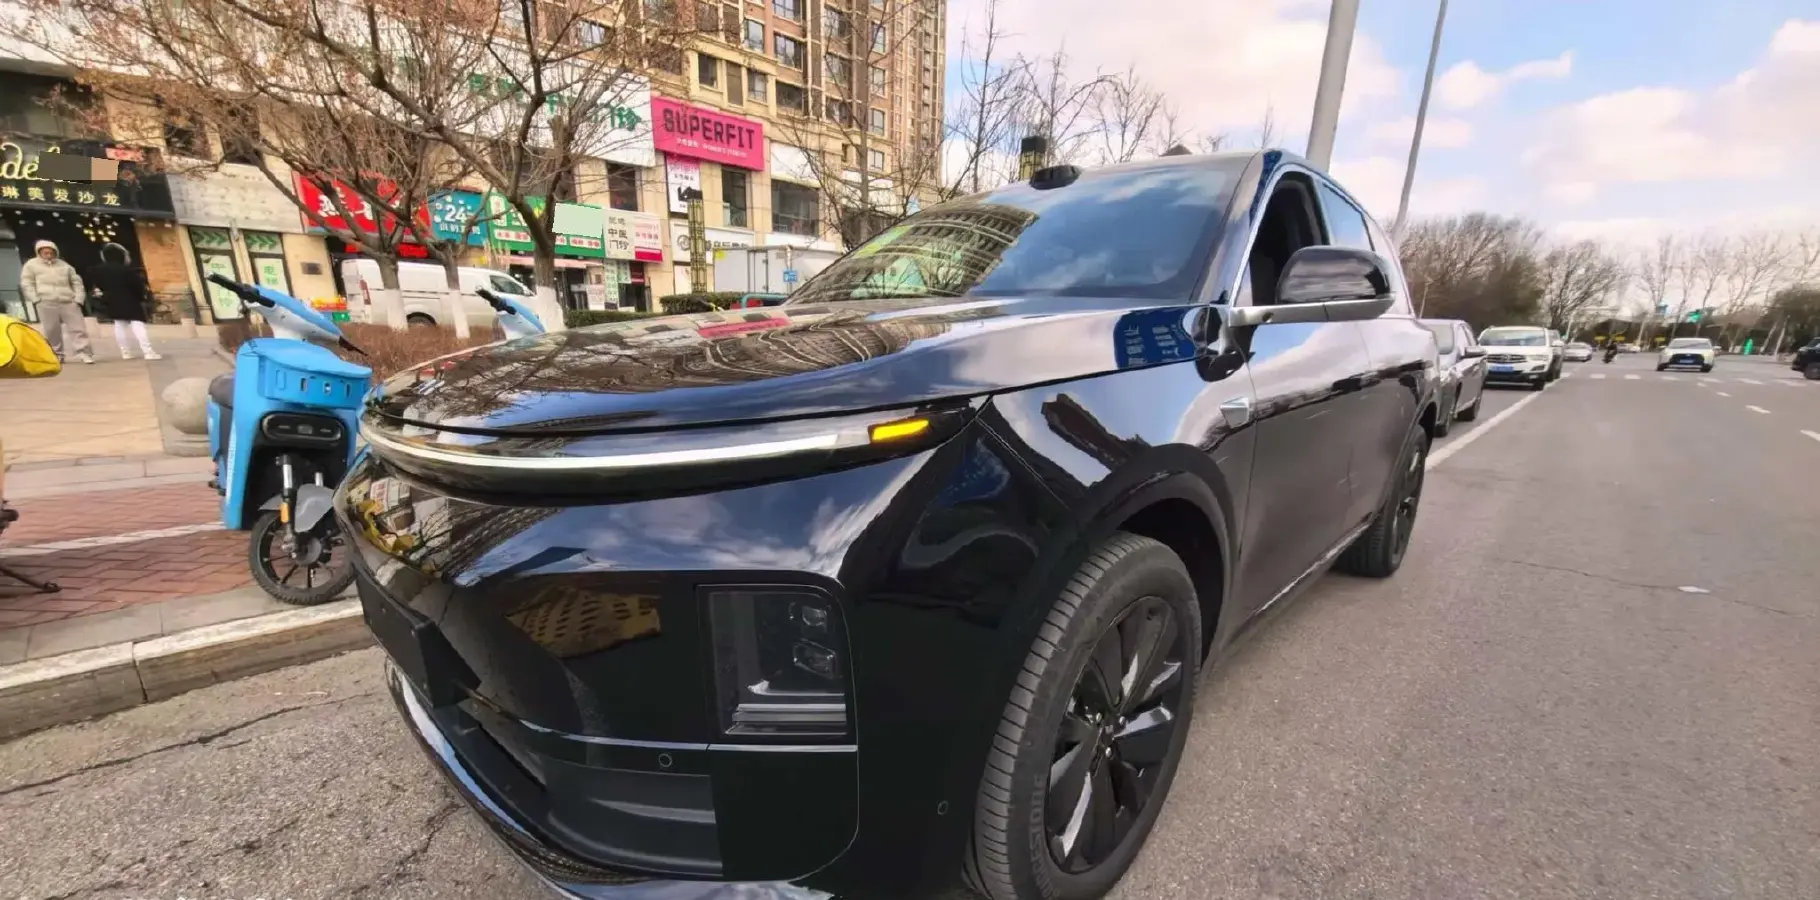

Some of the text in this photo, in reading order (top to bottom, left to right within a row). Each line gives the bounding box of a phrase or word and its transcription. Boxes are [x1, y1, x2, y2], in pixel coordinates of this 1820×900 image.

[663, 108, 754, 149] SUPERFIT
[608, 228, 628, 240] 中医
[608, 239, 630, 251] 门诊
